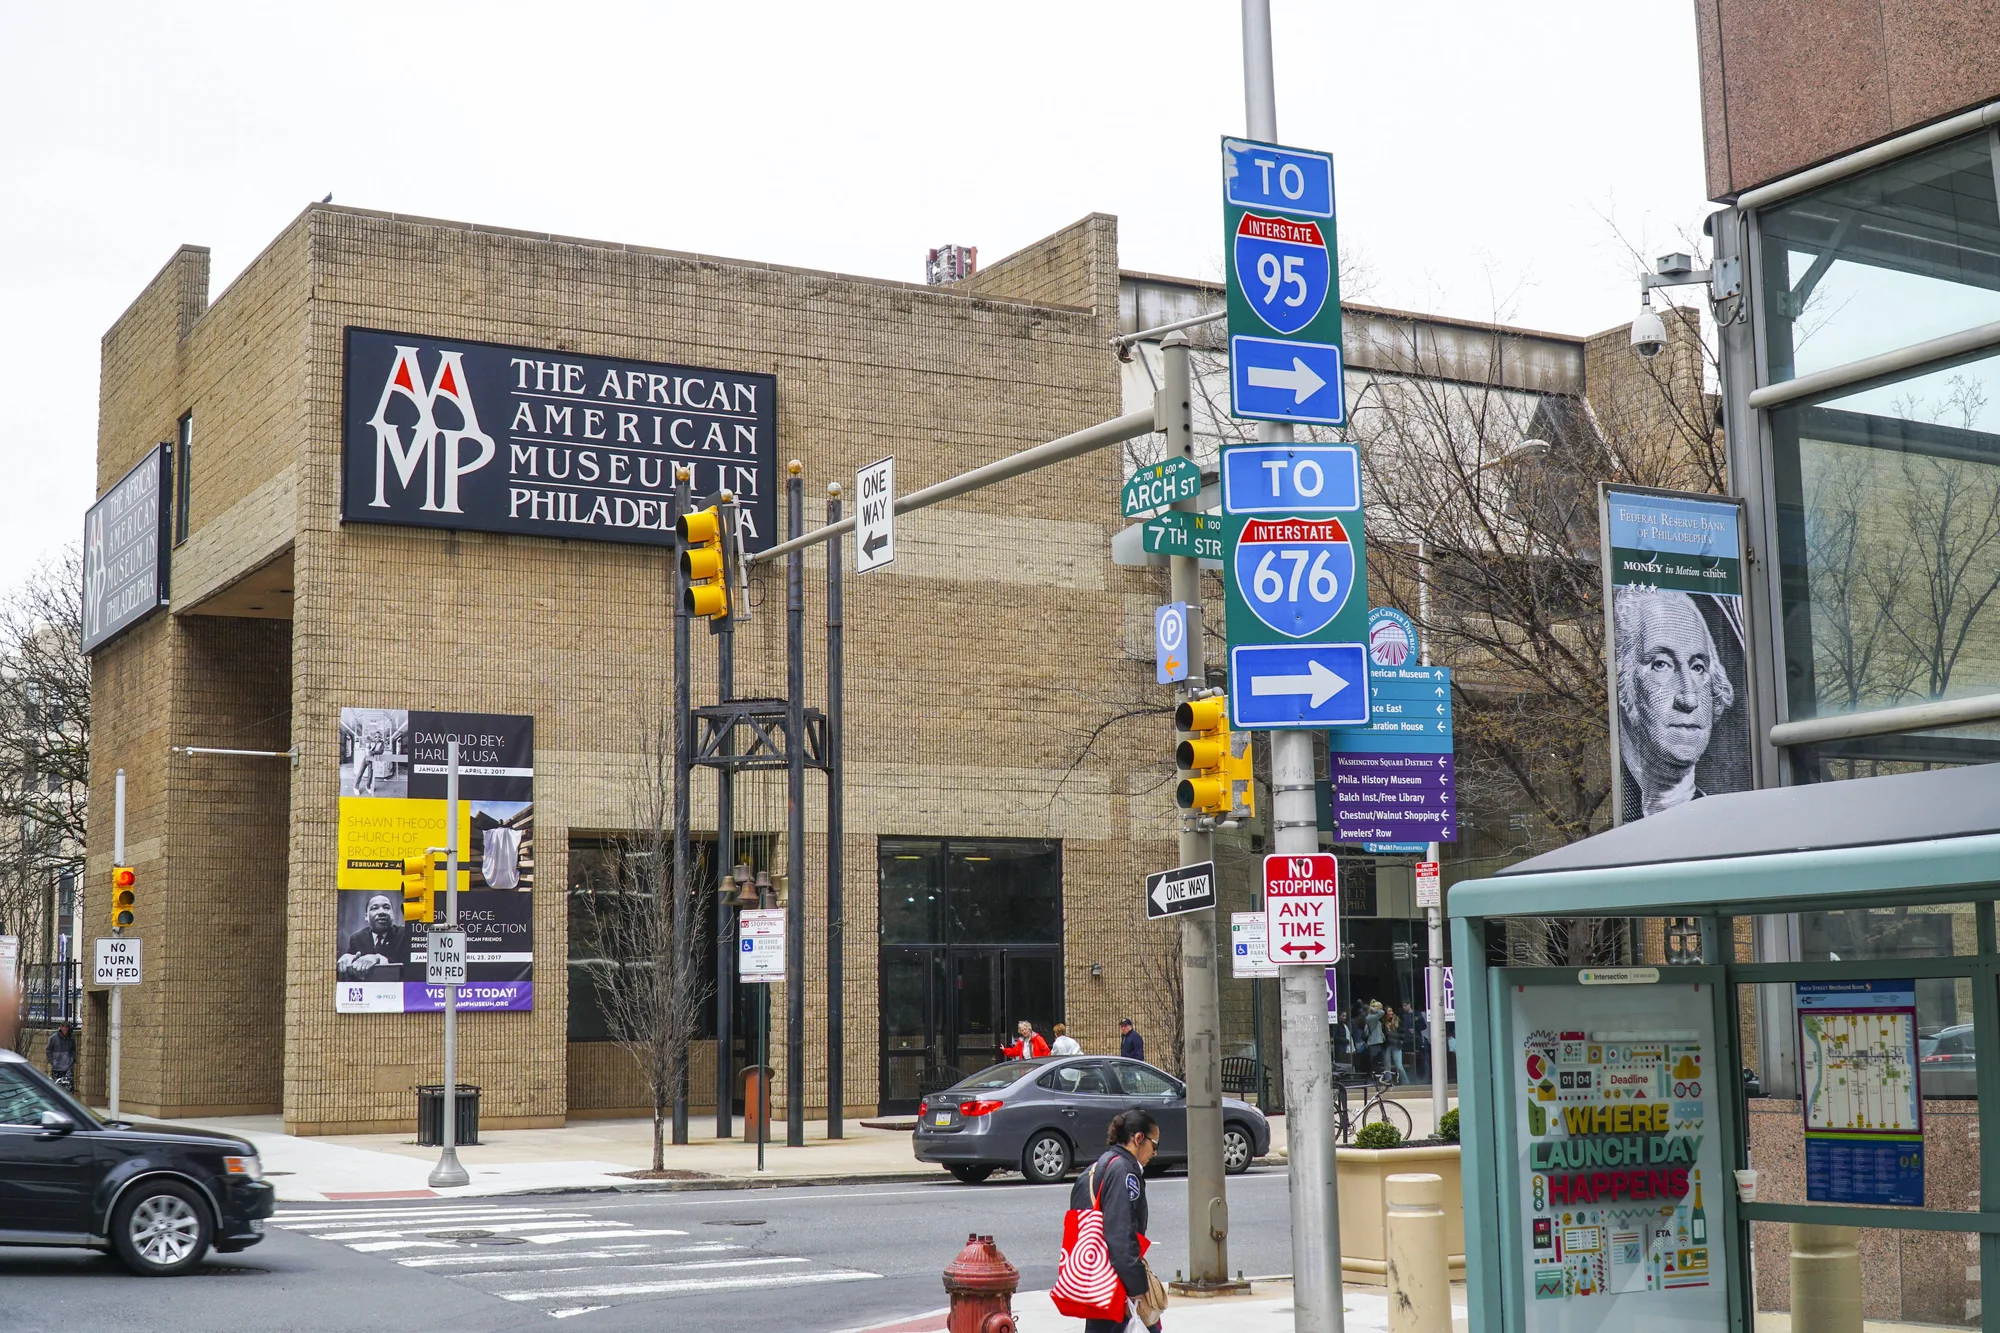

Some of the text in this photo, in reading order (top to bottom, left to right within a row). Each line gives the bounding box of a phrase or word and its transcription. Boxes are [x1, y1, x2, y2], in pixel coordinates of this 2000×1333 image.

[1255, 159, 1305, 200] TO
[1249, 220, 1312, 243] INTERSTATE
[1257, 253, 1307, 308] 95
[510, 357, 758, 414] THE AFRICAN
[509, 401, 758, 455] AMERICAN
[509, 443, 759, 497] MUSEUM IN
[1143, 463, 1177, 481] 700 W 600
[863, 469, 886, 499] ONE
[1262, 460, 1324, 497] TO
[110, 459, 157, 521] THE AFRICAN
[1126, 476, 1196, 513] ARCH ST
[508, 487, 759, 540] PHILADELA
[863, 497, 887, 527] WAY
[108, 495, 156, 557] AMERICAN
[1179, 516, 1221, 530] 1 N 100
[1620, 509, 1726, 532] FEDERAL RESERVE BANK
[1254, 525, 1334, 541] INTERSTATE
[1637, 527, 1713, 545] OF PHILADELPHIA
[107, 532, 155, 592] MUSEUM IN
[1253, 550, 1338, 603] 676
[1623, 561, 1727, 579] MONEY in Motion exhibit
[106, 571, 155, 627] PHILADELPHIA
[1380, 609, 1416, 656] CENTER DISTRICT
[1399, 670, 1430, 680] Museum
[1386, 704, 1402, 713] East
[1400, 722, 1424, 731] House
[415, 732, 505, 747] DAWOUD BEY:
[414, 749, 499, 763] HARLM, USA
[1338, 757, 1433, 767] WASHINGTON SQUARE DISTRICT
[1338, 775, 1422, 786] Phila. History Museum
[1339, 793, 1425, 804] Balch Inst./Free Library
[347, 816, 393, 828] SHAWN
[1339, 810, 1440, 822] Chestnut/Walnut Shopping
[347, 831, 419, 843] CHURCH OF
[1340, 829, 1392, 839] Jewelers' Row
[347, 845, 394, 858] BROKEN
[1288, 858, 1313, 878] NO
[1166, 877, 1207, 901] ONE WAY
[1269, 879, 1334, 894] STOPPING
[459, 911, 495, 921] PEACE:
[1278, 902, 1324, 917] ANY
[467, 924, 482, 933] OF
[485, 924, 527, 933] ACTION
[1278, 922, 1325, 937] TIME
[111, 943, 126, 952] NO
[440, 938, 453, 948] NO
[104, 956, 134, 964] TURN
[434, 952, 460, 963] TURN
[98, 968, 138, 977] ON RED
[430, 966, 464, 977] ON RED
[458, 989, 473, 998] US
[474, 988, 517, 998] TODAY!
[1562, 1075, 1589, 1084] 01 04
[1611, 1074, 1648, 1084] Deadline
[1563, 1103, 1670, 1135] WHERE
[1531, 1135, 1704, 1169] LAUNCH DAY
[1548, 1168, 1689, 1205] HAPPENS
[1656, 1229, 1670, 1237] ETA
